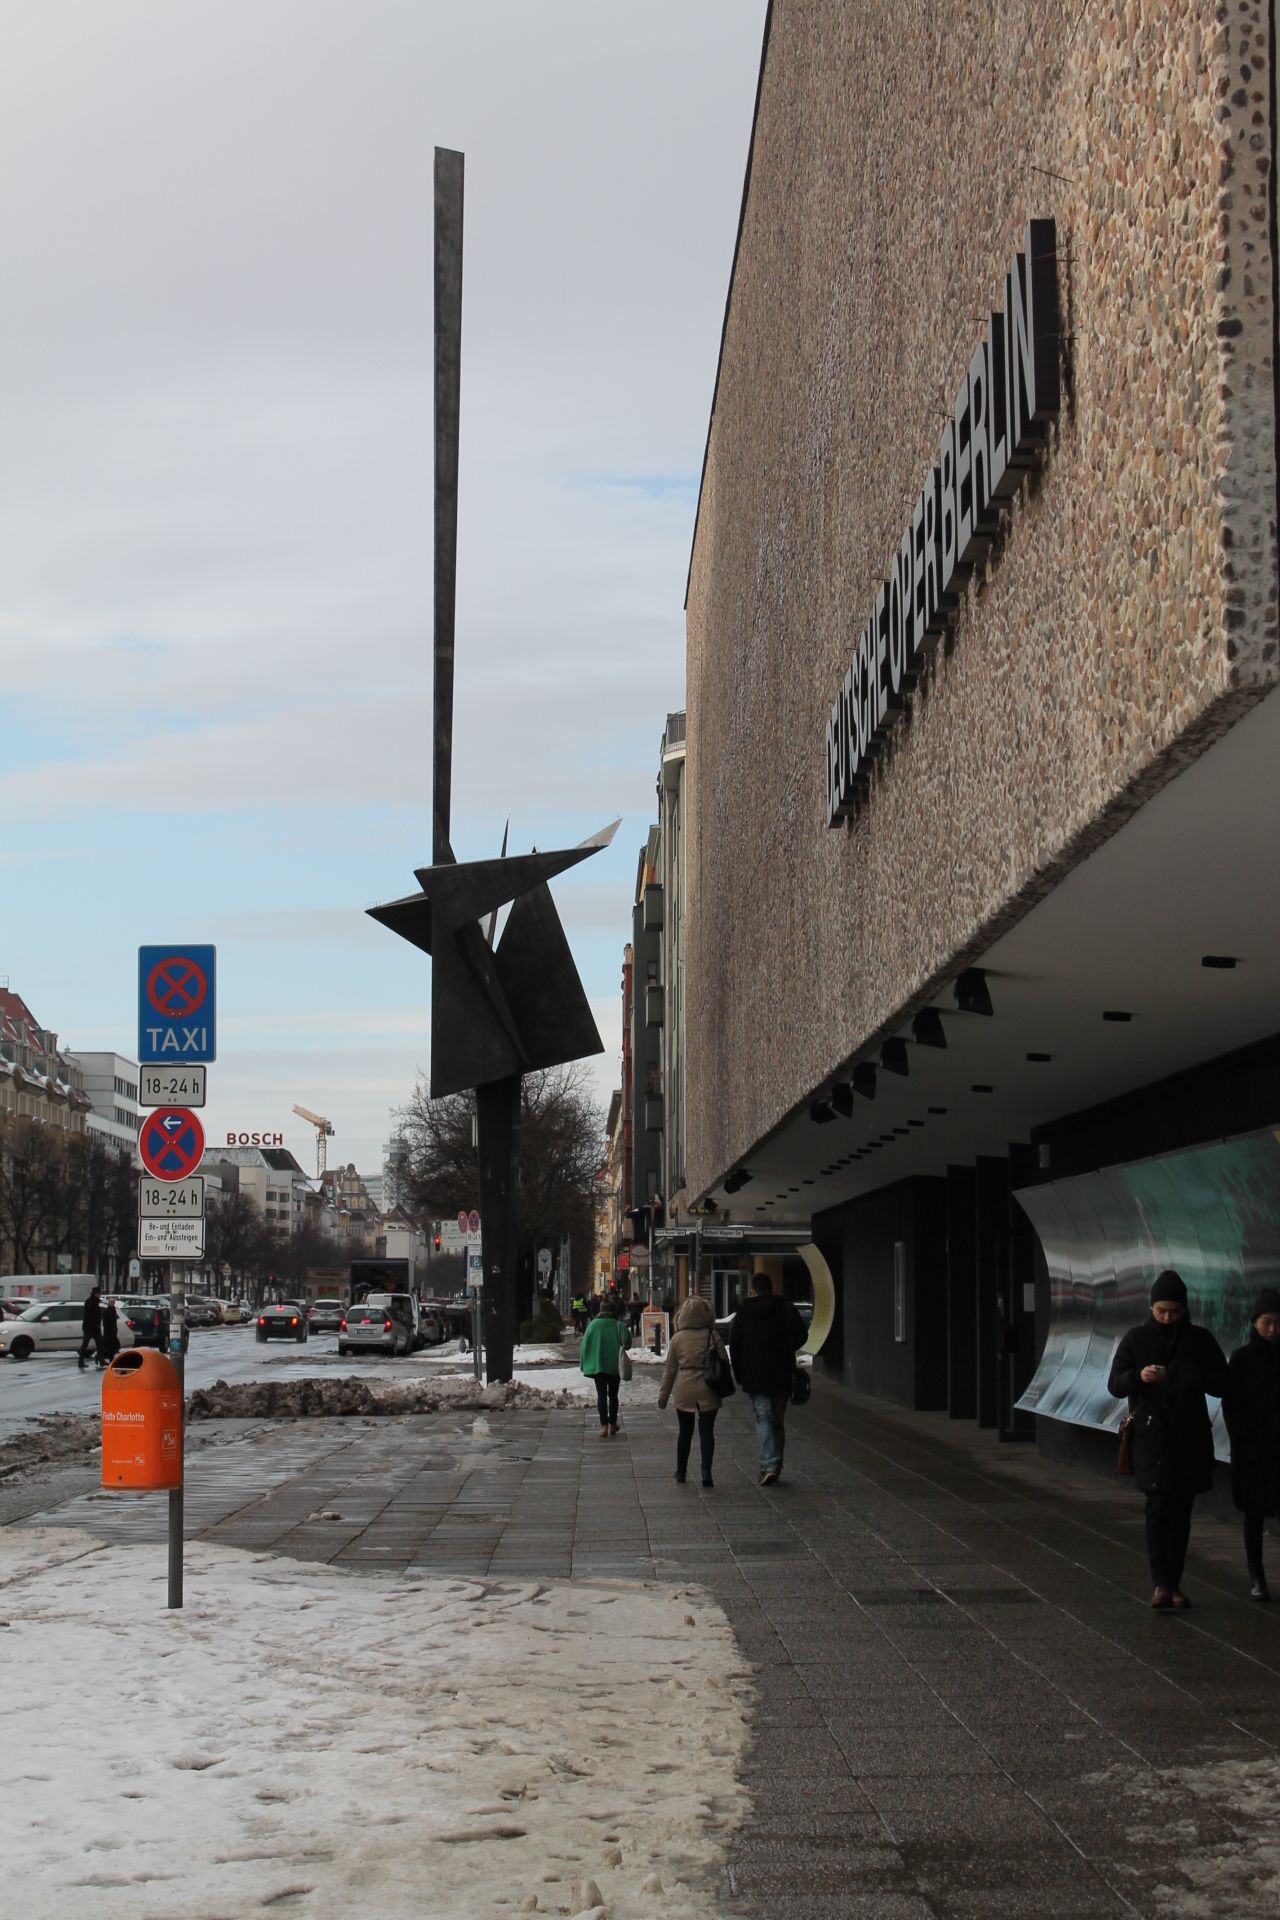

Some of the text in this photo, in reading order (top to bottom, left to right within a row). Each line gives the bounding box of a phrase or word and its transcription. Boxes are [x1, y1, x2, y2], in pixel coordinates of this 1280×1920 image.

[826, 219, 1053, 827] DEUTSCHE OPER BERLIN
[146, 1028, 207, 1052] TAXI
[146, 1078, 200, 1094] 18-24 h
[227, 1132, 283, 1145] BOSCH
[145, 1189, 198, 1205] 18-24 h
[160, 1222, 170, 1231] und
[171, 1222, 195, 1231] Entladen
[157, 1233, 167, 1241] und
[169, 1233, 198, 1242] Aussteigen
[165, 1243, 178, 1252] frei
[116, 1411, 145, 1422] Charlotte
